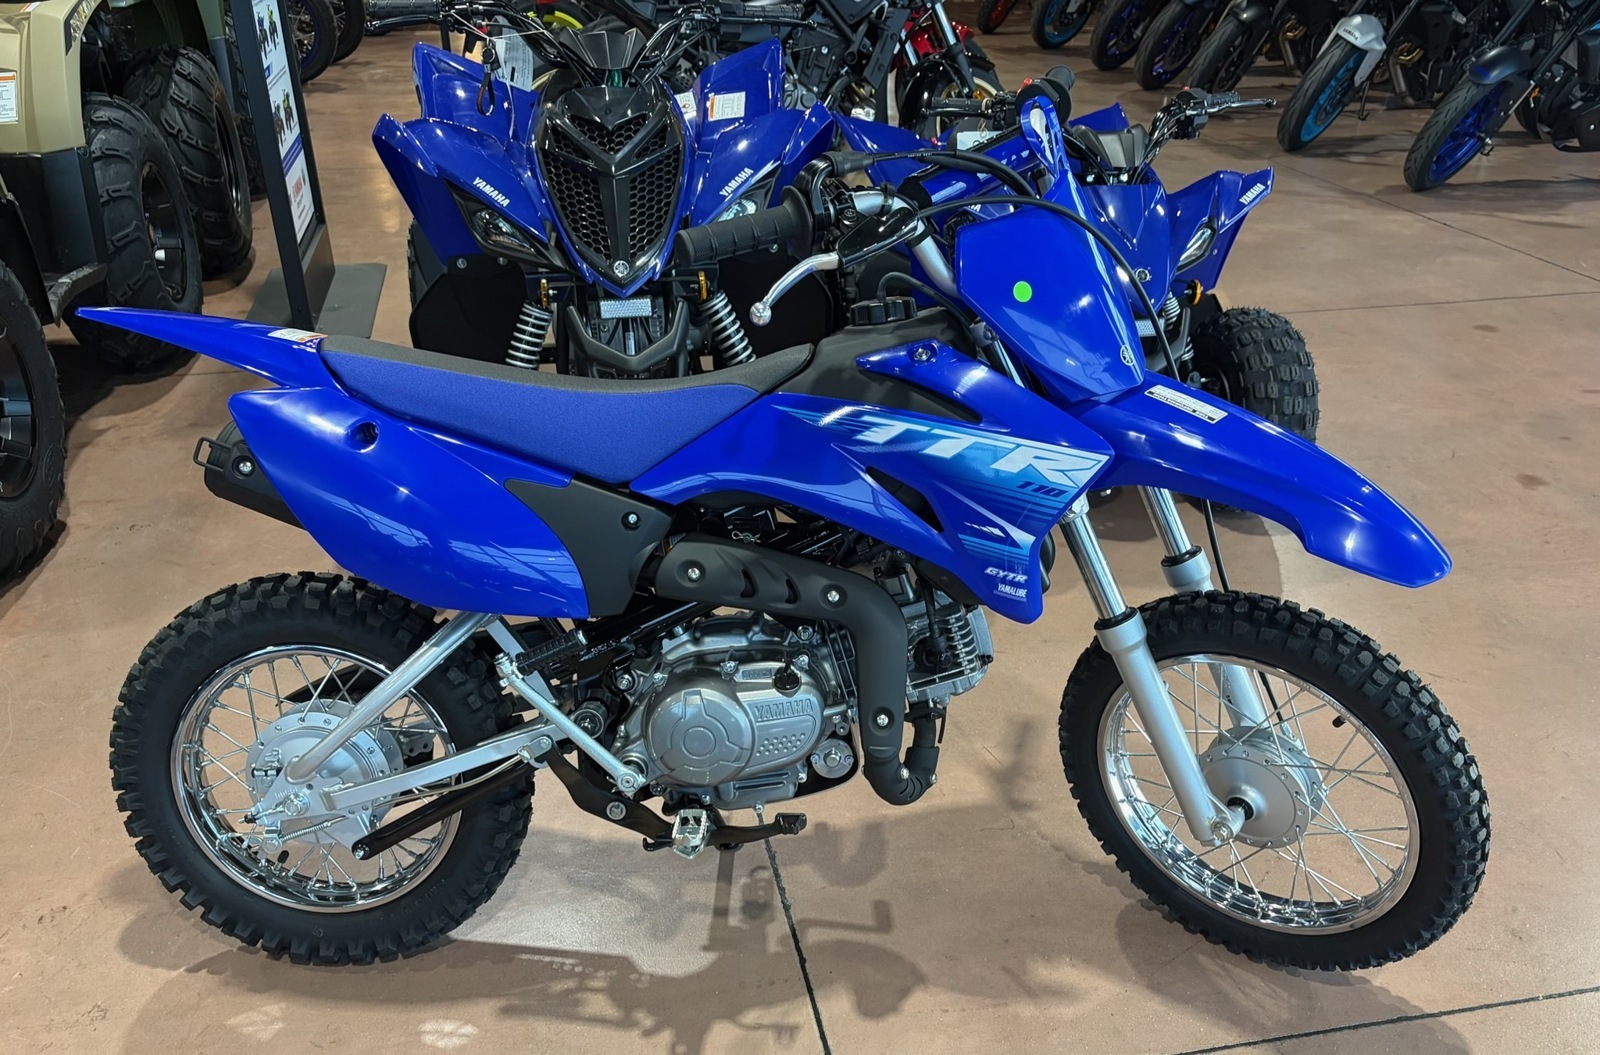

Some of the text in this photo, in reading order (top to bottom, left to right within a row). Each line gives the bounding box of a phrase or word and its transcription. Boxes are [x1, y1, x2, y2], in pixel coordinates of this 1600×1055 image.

[1342, 27, 1359, 41] YAMAHA
[473, 176, 510, 207] YAMAHA
[719, 167, 754, 196] YAMAHA
[1239, 183, 1266, 205] YAMAHA
[851, 415, 1107, 488] TTR
[1016, 480, 1069, 499] 110
[983, 566, 1028, 584] GYTR
[997, 583, 1028, 598] YAMALUBE
[755, 698, 814, 721] YAMAHA
